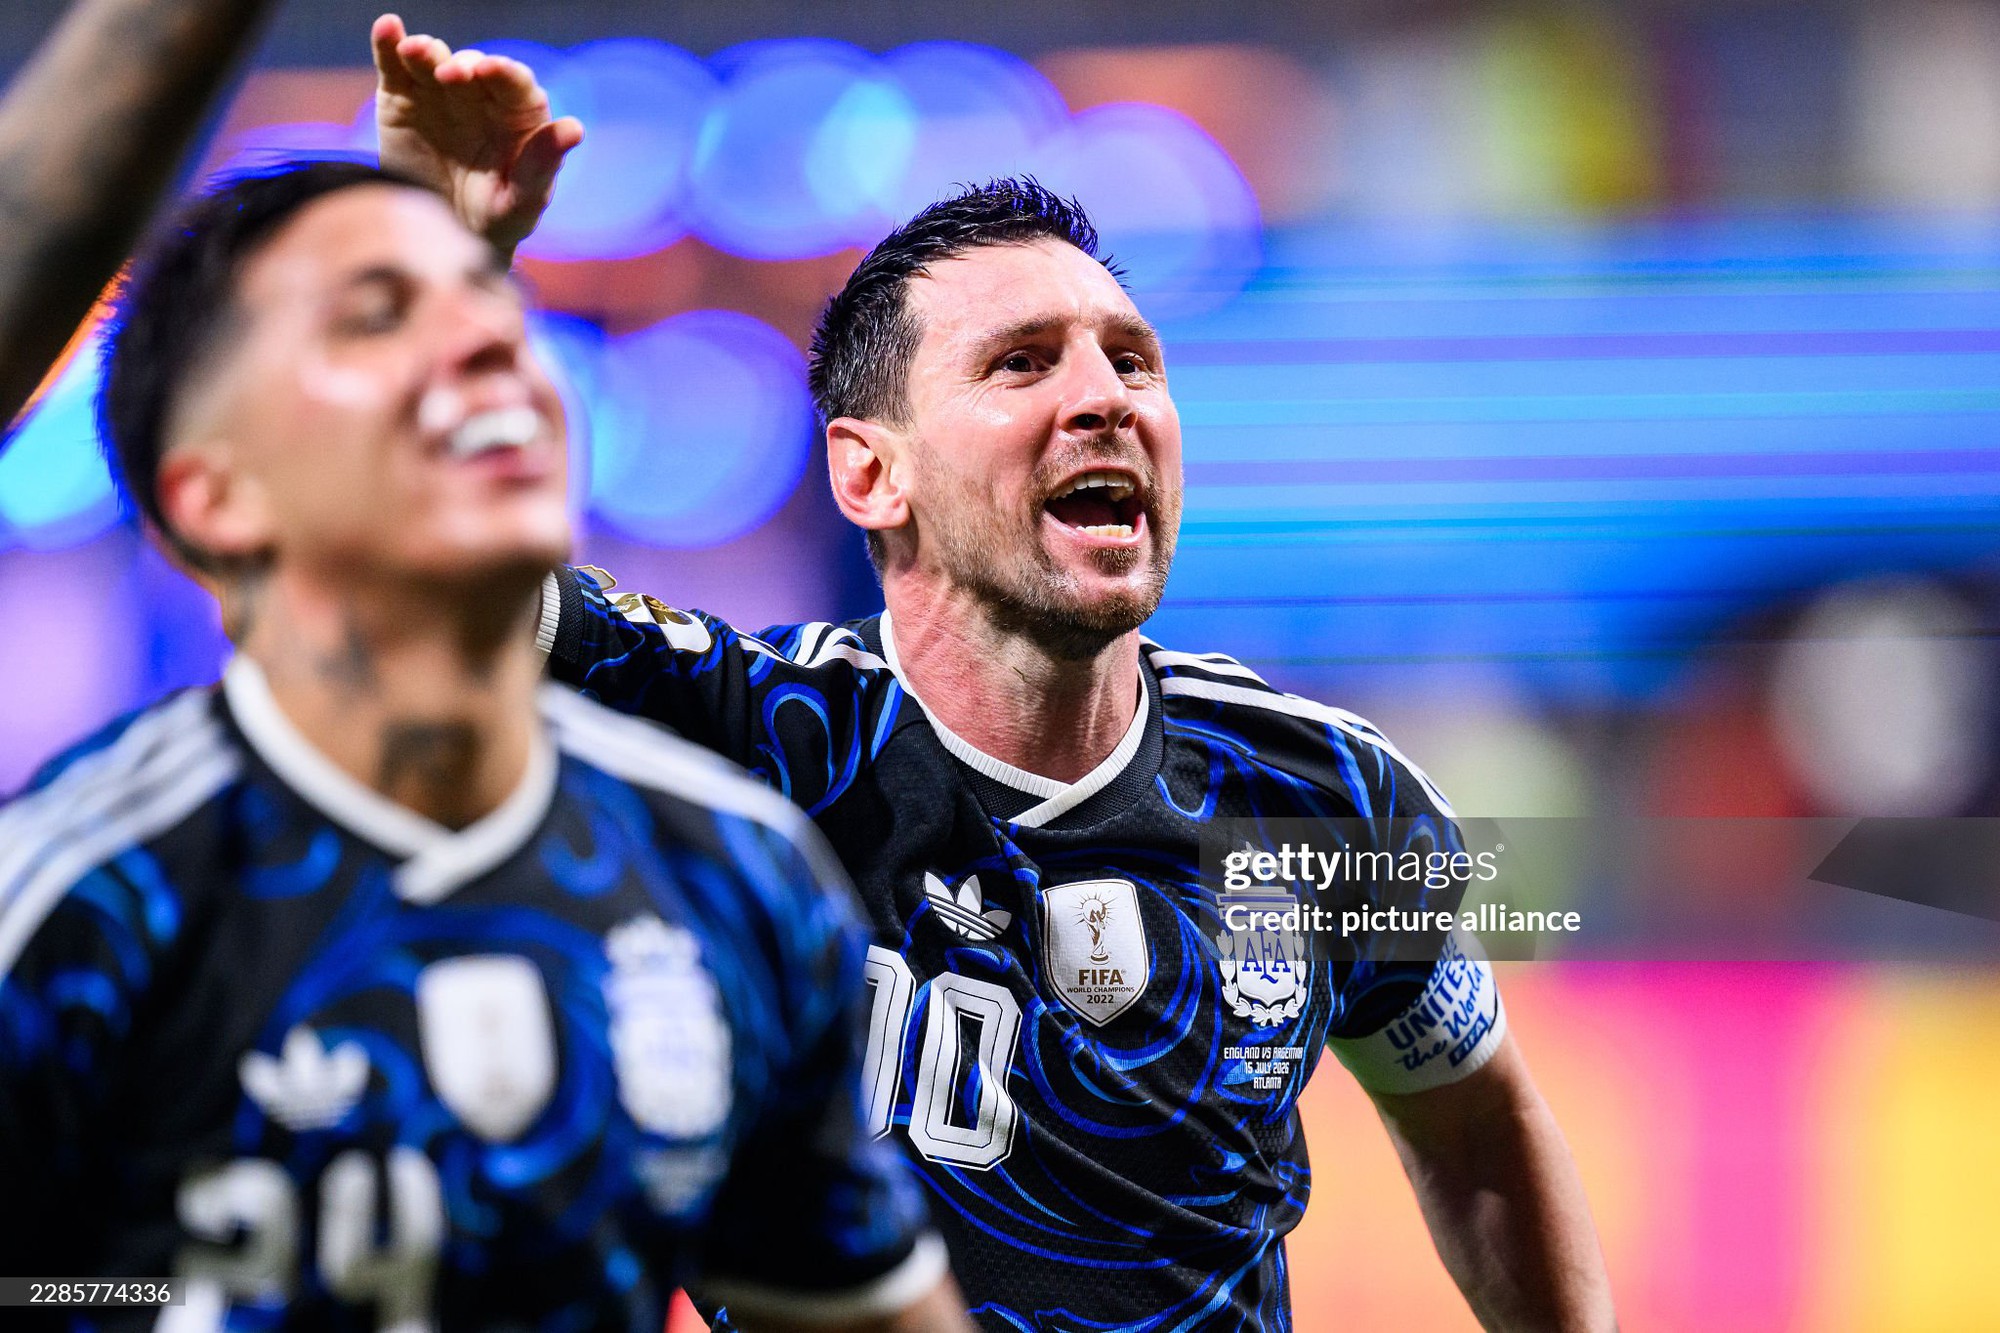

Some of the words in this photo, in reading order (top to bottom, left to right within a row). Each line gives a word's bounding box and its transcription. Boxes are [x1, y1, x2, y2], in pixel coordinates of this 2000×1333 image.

[1078, 969, 1124, 986] FIFA
[1066, 986, 1092, 994] WORLD
[1385, 944, 1466, 1050] UNITES
[1086, 994, 1114, 1004] 2022
[1394, 1040, 1448, 1071] the
[1442, 956, 1484, 1039] World
[861, 944, 1023, 1171] 10
[1223, 1047, 1260, 1060] ENGLAND
[1261, 1047, 1272, 1060] VS
[1272, 1046, 1304, 1060] ARGENTINA
[1244, 1061, 1253, 1074] 15
[1254, 1061, 1272, 1074] JULY
[1272, 1061, 1290, 1074] 2026
[1253, 1076, 1282, 1090] ATLANTA
